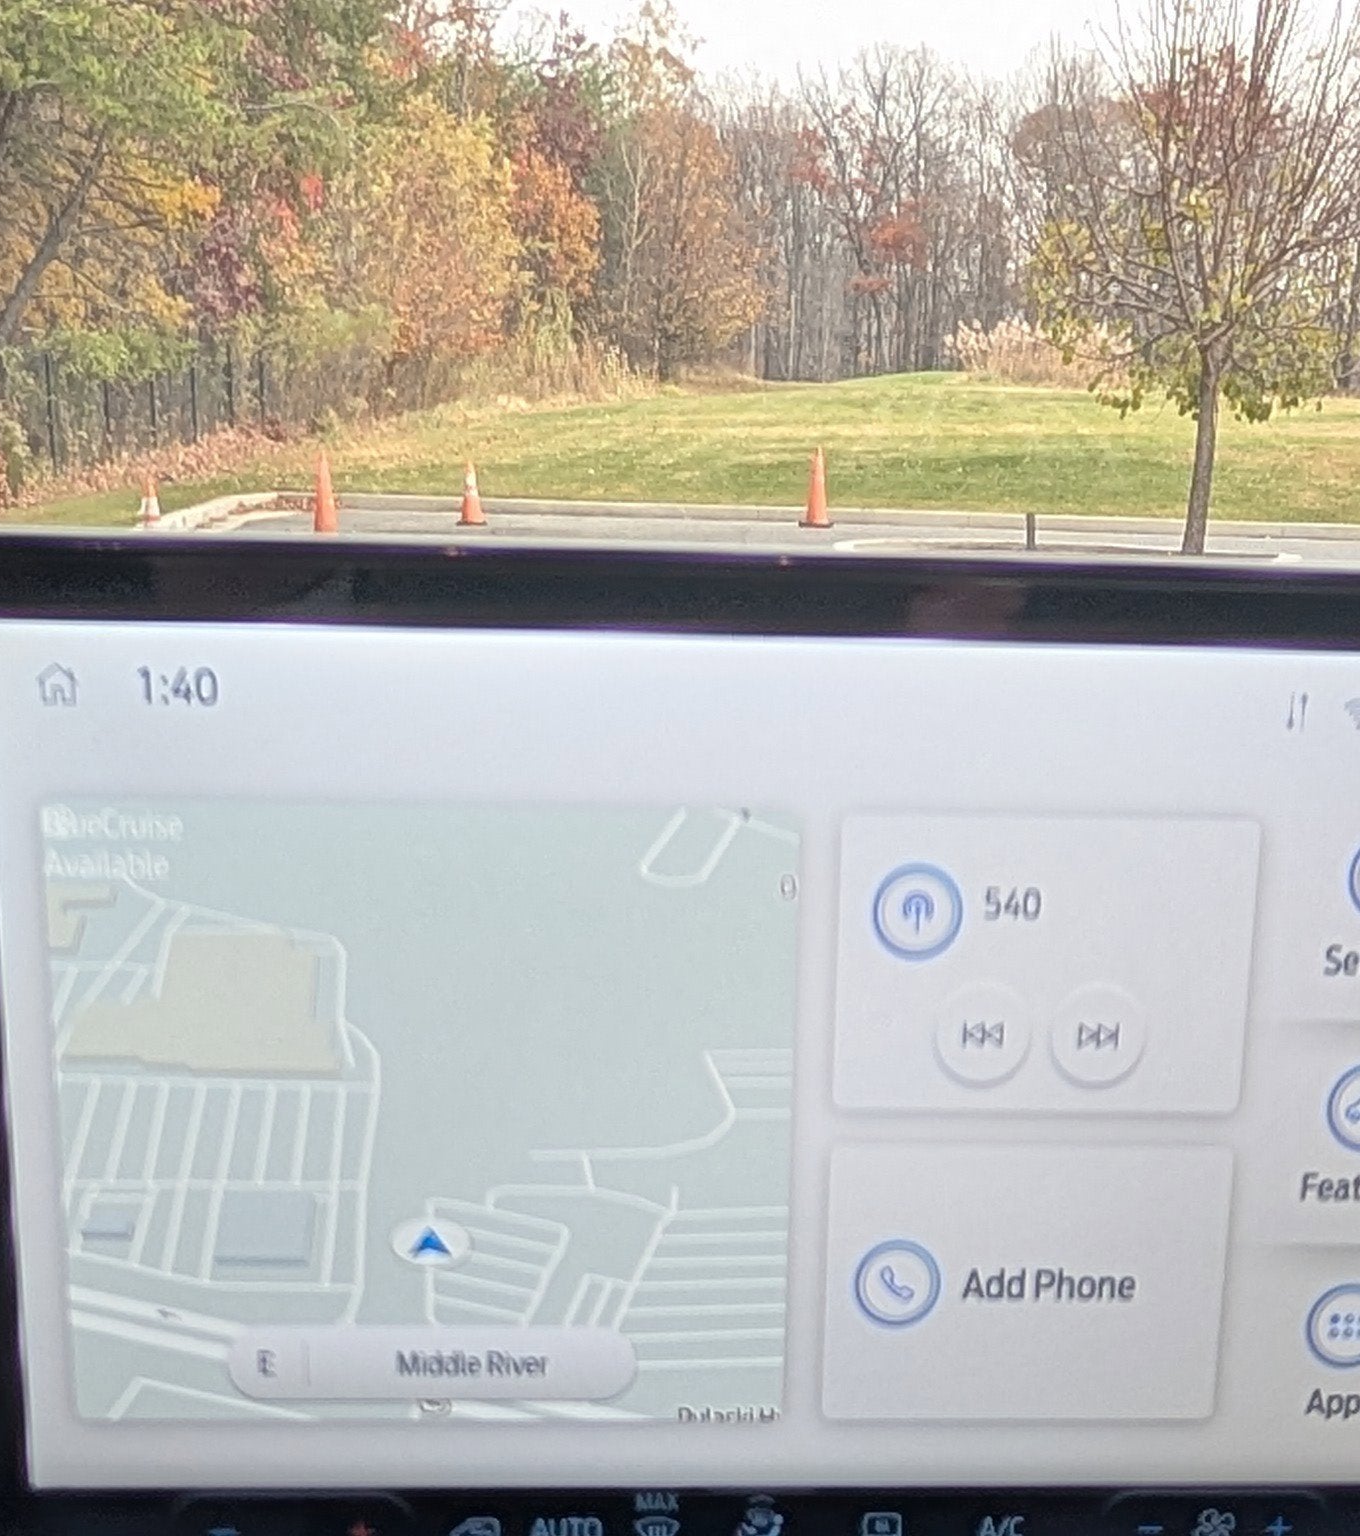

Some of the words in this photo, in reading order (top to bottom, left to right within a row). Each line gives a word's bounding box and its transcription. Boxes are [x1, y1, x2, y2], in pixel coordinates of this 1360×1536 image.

[136, 664, 219, 708] 1:40
[44, 848, 170, 881] Available
[984, 886, 1042, 921] 540
[962, 1268, 1028, 1300] Add
[1034, 1269, 1137, 1301] Phone
[395, 1349, 482, 1378] Middle
[485, 1349, 549, 1377] River
[634, 1491, 678, 1513] MAX
